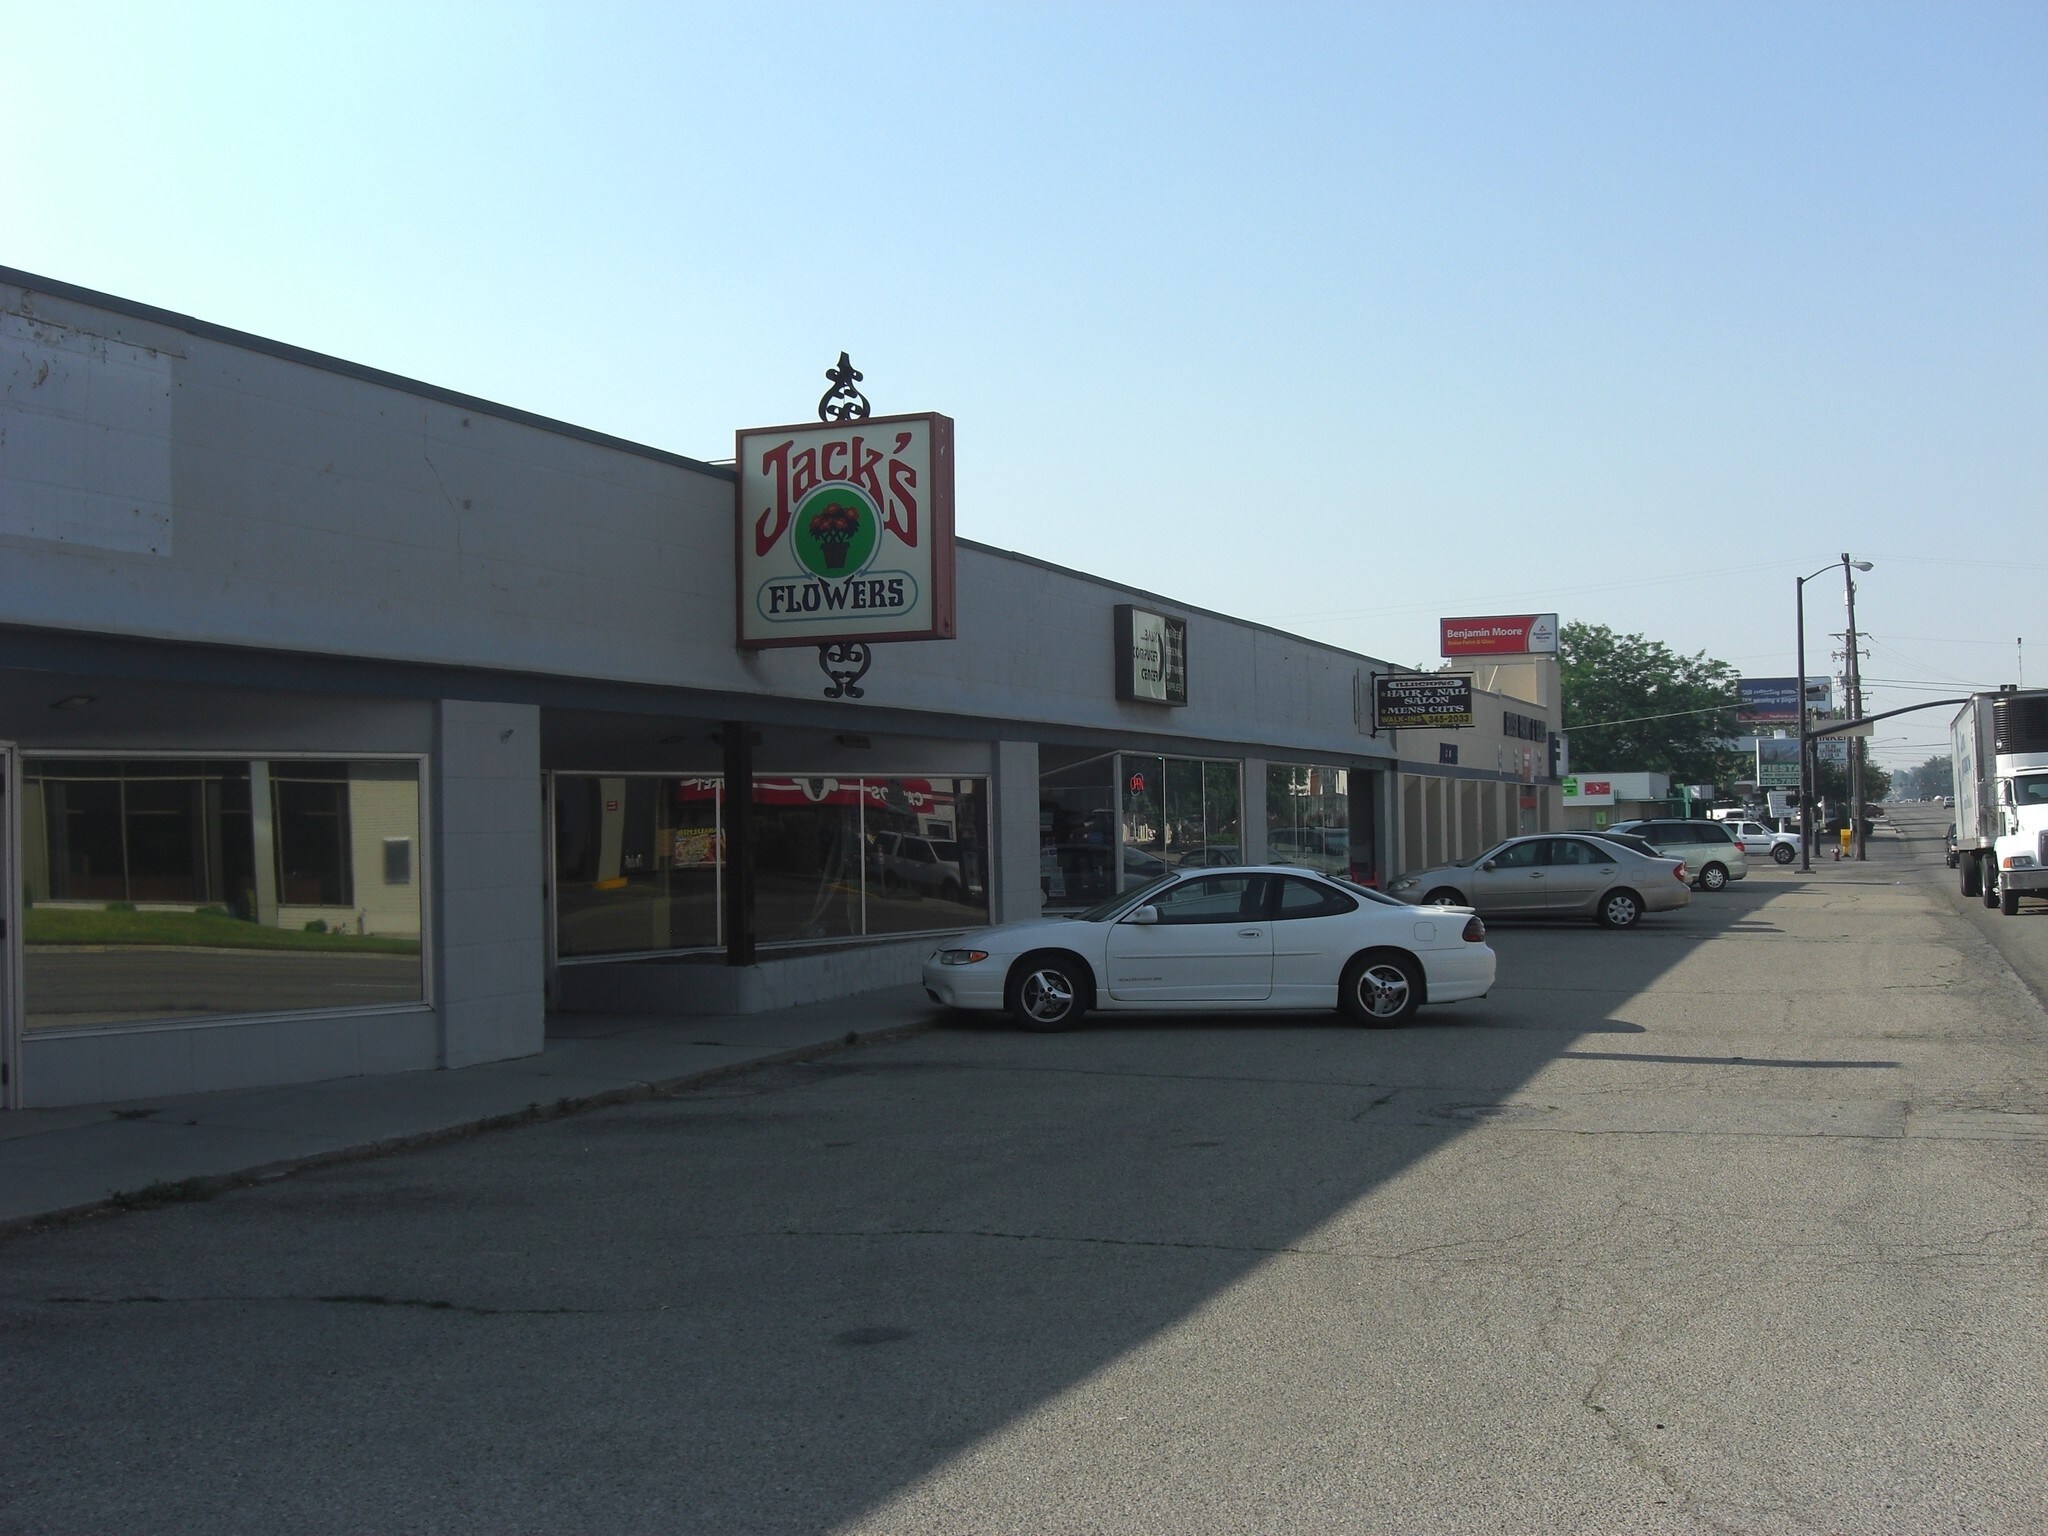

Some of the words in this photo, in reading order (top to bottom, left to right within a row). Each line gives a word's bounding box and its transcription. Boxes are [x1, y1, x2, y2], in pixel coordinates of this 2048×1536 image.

[755, 432, 918, 557] Jack's
[768, 575, 905, 614] FLOWERS
[1447, 628, 1490, 639] Benjamin
[1492, 627, 1523, 636] Moore
[1387, 689, 1423, 698] HAIR
[1437, 687, 1469, 696] NAIL
[1404, 696, 1450, 705] SALON
[1387, 705, 1425, 714] MENS
[1429, 704, 1465, 713] CUTS
[1428, 714, 1470, 723] 345-2033
[1761, 764, 1800, 772] FIESTA
[1130, 777, 1144, 791] OPEN
